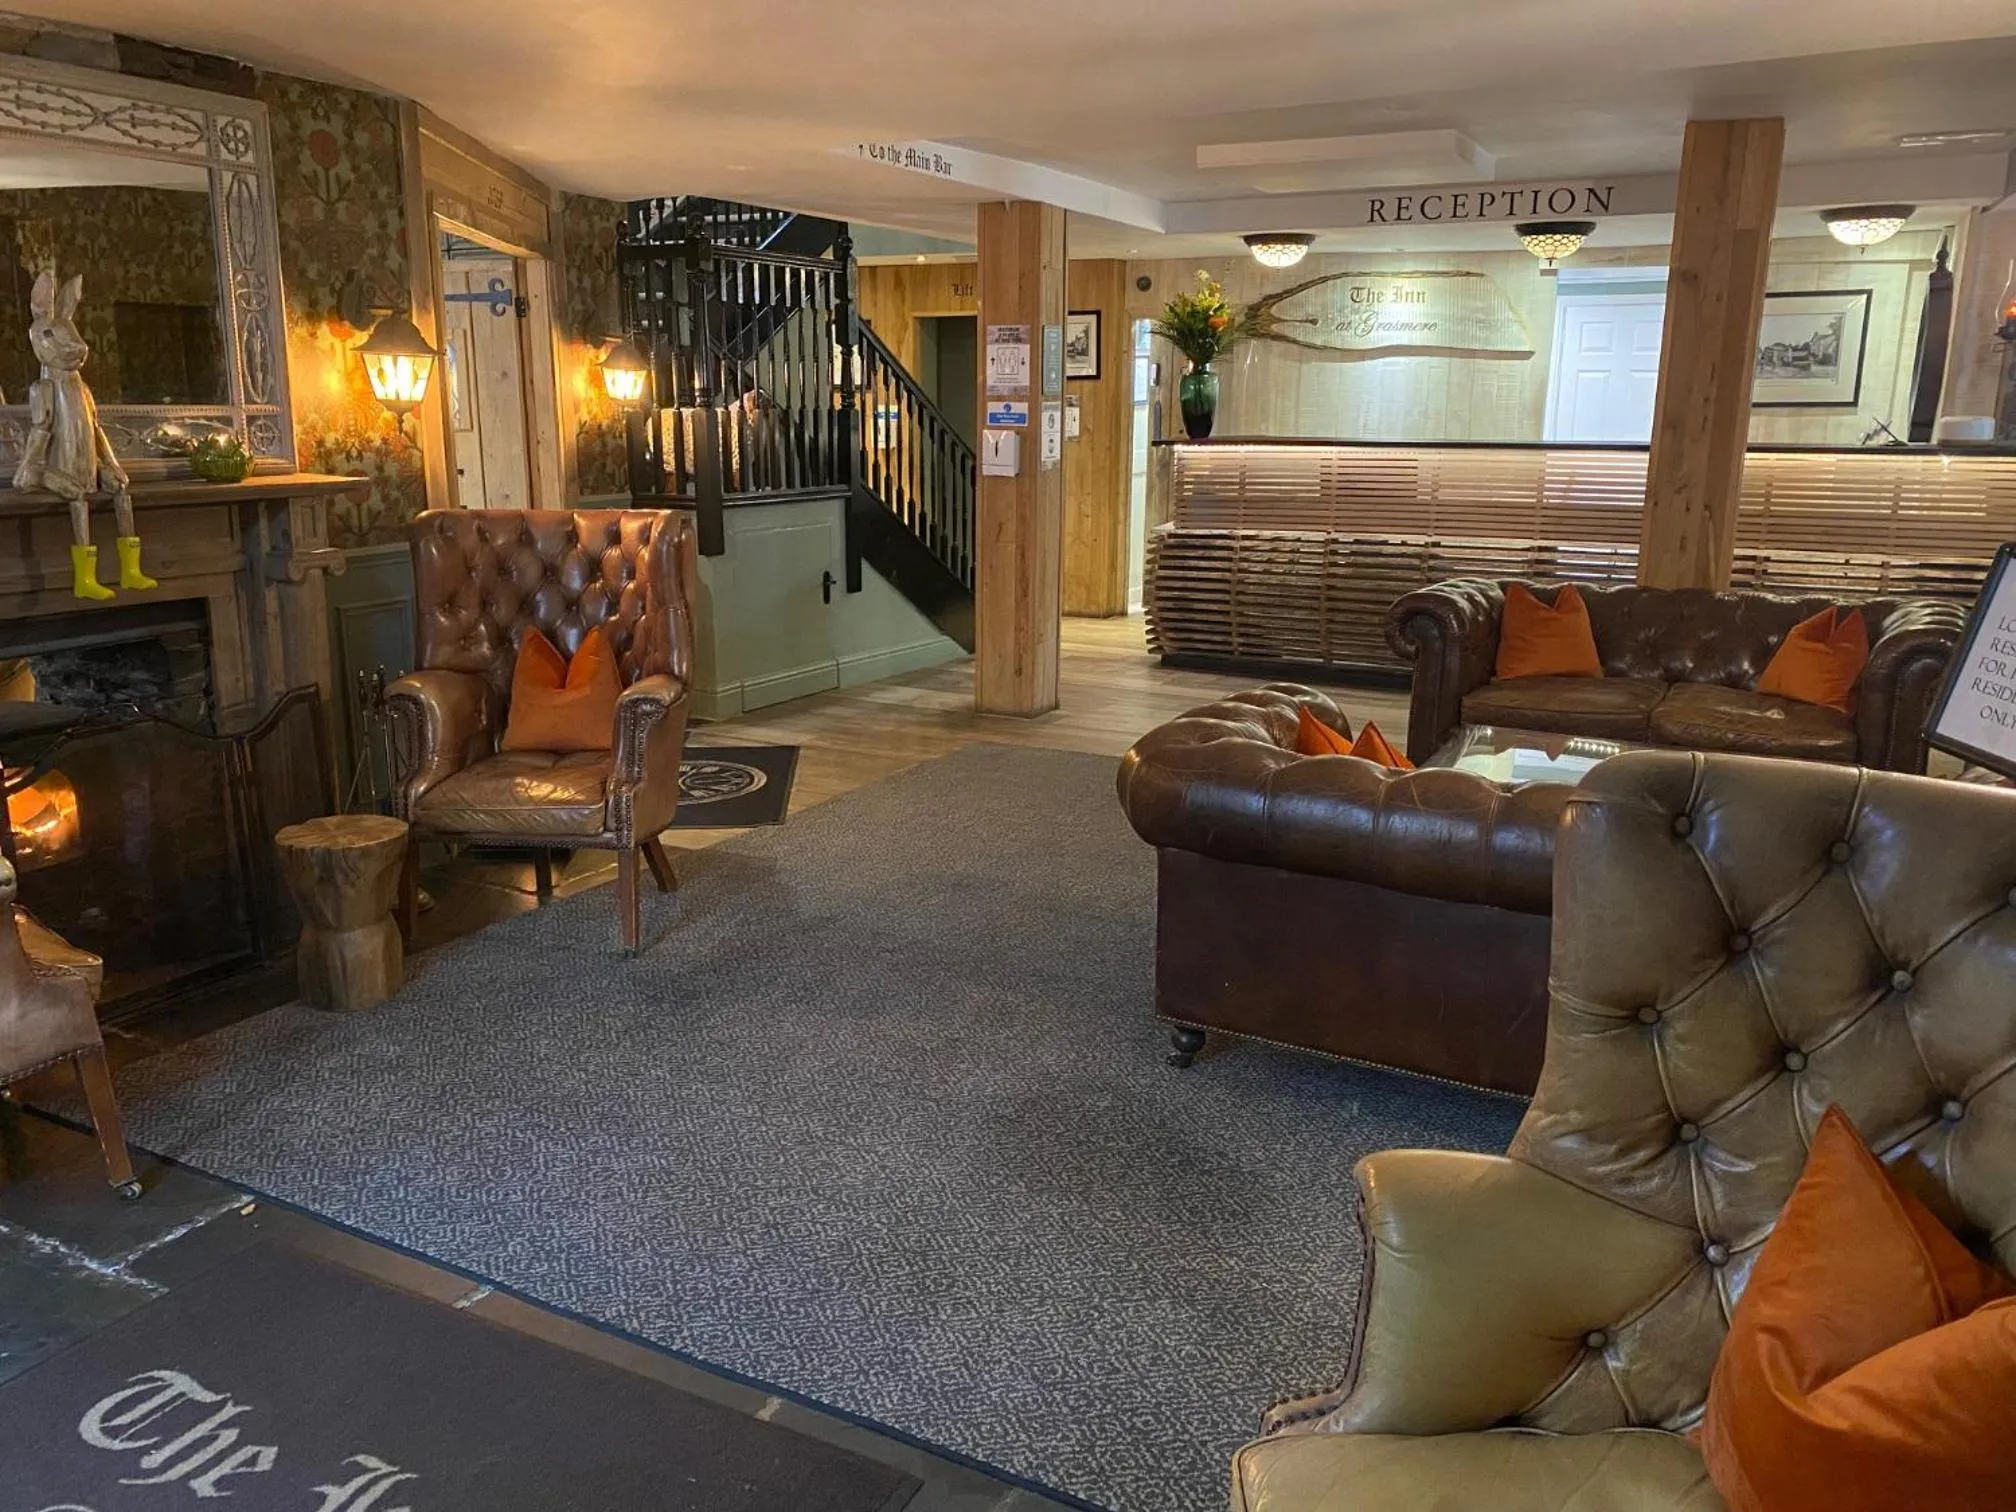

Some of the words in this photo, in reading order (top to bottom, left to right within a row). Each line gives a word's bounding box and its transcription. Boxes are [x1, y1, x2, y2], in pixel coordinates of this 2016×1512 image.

[868, 143, 886, 160] To
[887, 144, 902, 167] the
[904, 147, 932, 171] Main
[933, 153, 953, 176] Bar
[1367, 186, 1616, 224] RECEPTION
[1349, 286, 1384, 307] The
[1391, 284, 1427, 304] Inn
[1335, 320, 1353, 333] at
[1354, 310, 1439, 338] Grasmere
[1978, 656, 2007, 678] FOR
[77, 1369, 279, 1498] The
